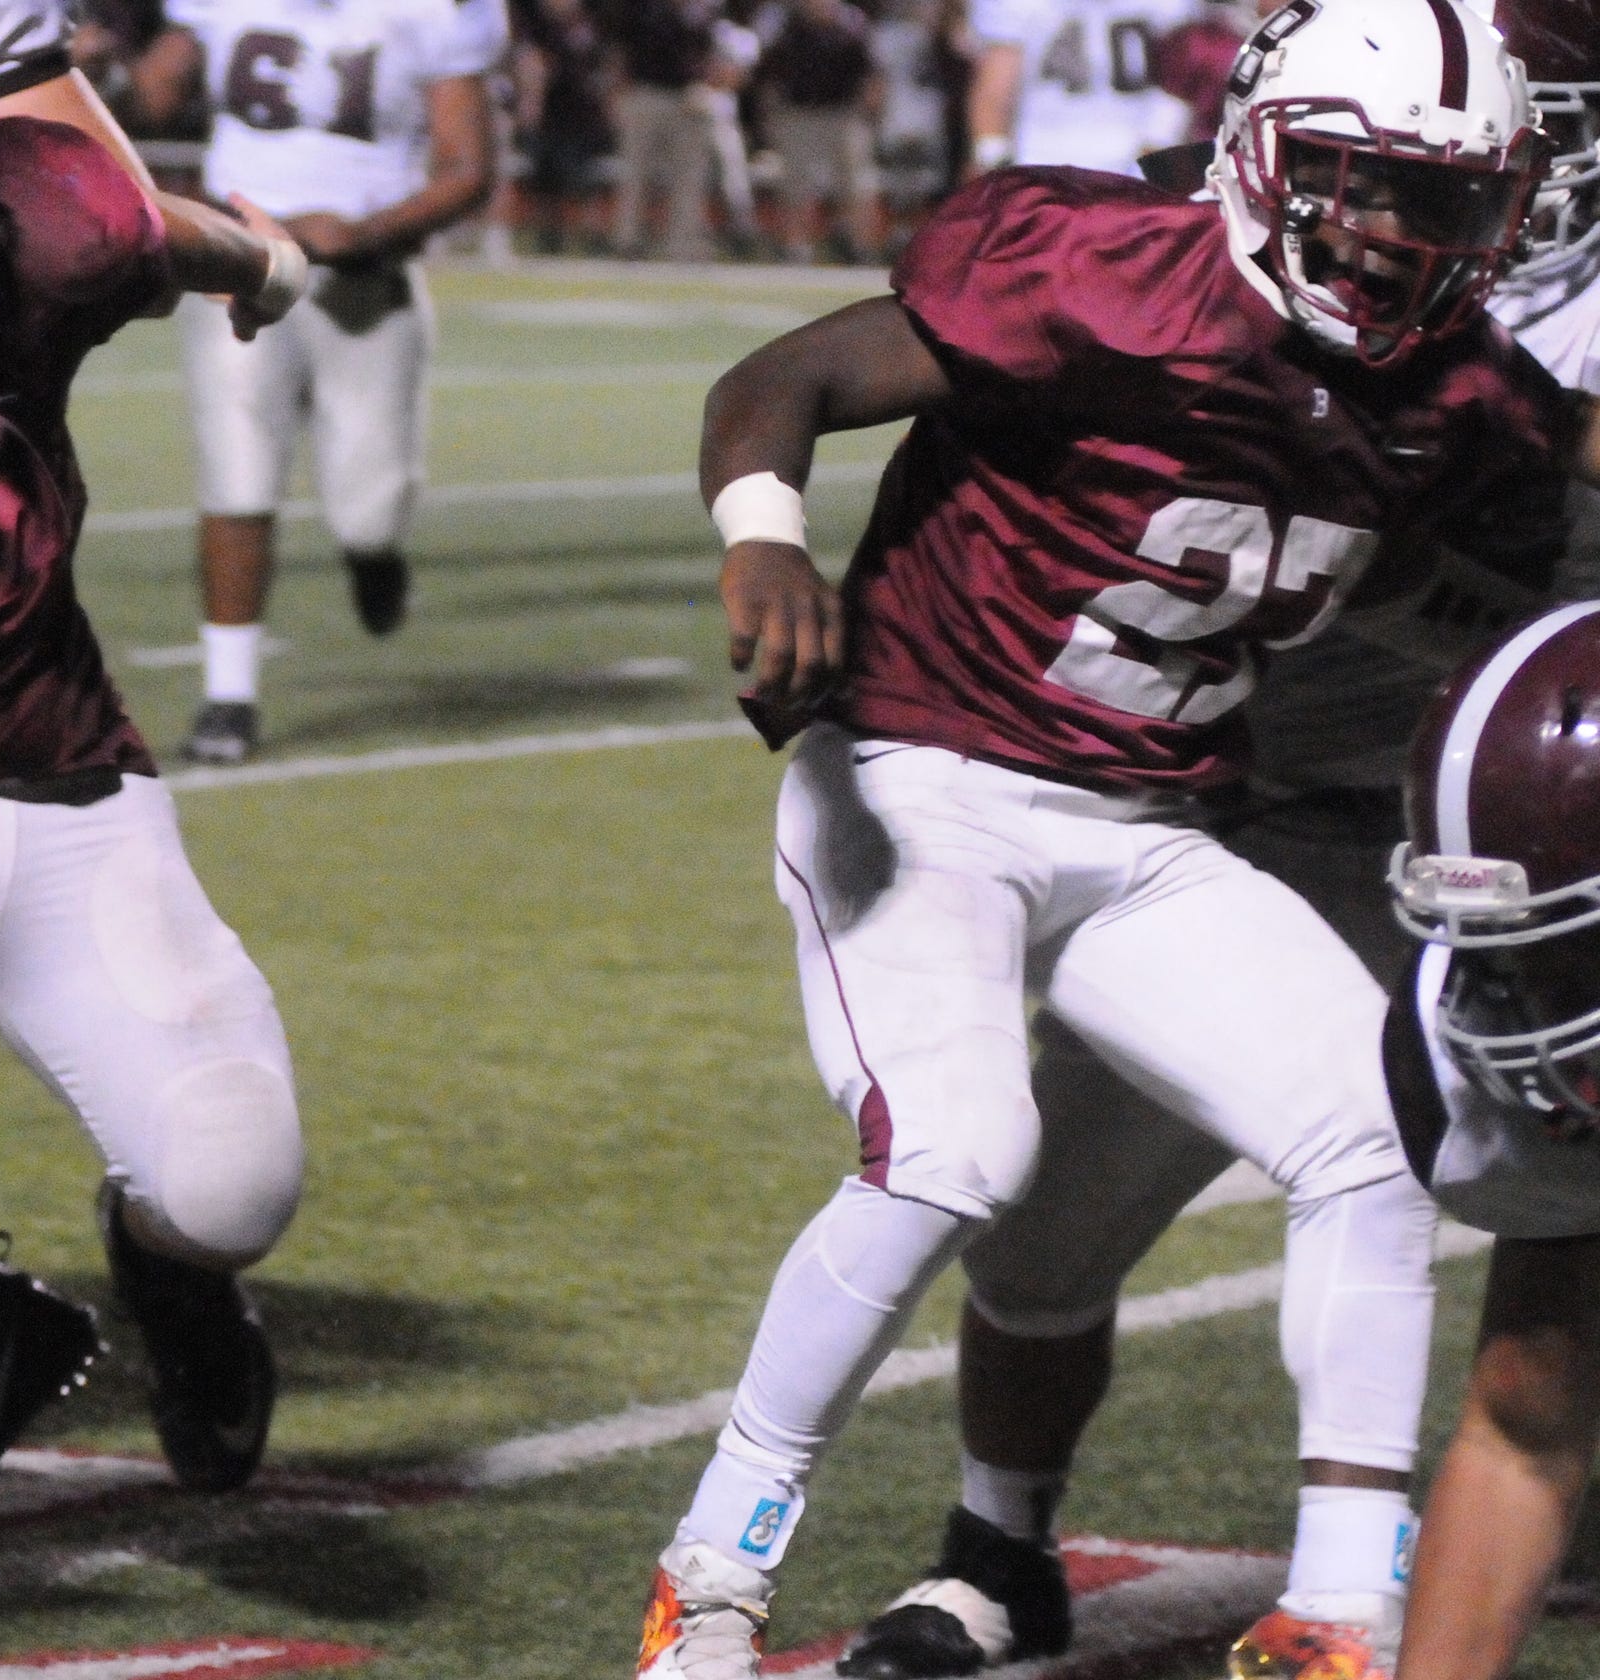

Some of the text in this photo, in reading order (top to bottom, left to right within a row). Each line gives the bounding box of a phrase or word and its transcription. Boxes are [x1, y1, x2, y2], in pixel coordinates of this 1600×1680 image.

[225, 30, 376, 142] 61
[1040, 18, 1158, 92] 40
[1043, 497, 1378, 725] 27
